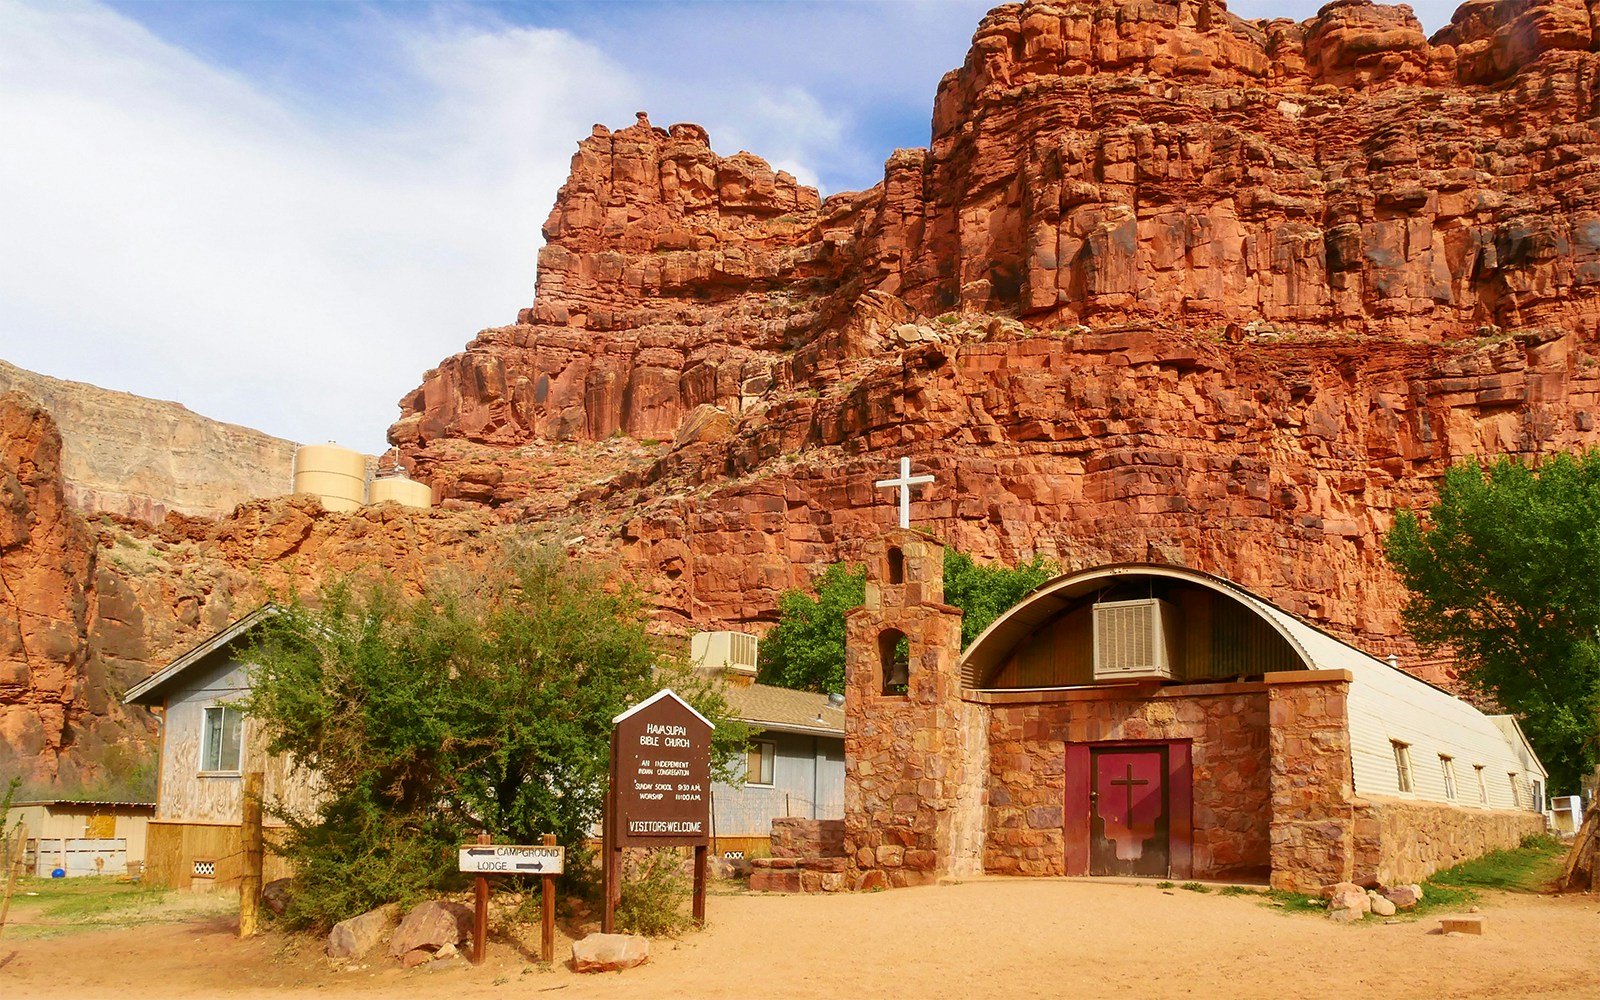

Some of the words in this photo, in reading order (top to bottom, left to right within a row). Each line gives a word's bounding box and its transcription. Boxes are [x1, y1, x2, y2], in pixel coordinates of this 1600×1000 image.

[646, 723, 687, 736] HAVASUPAI
[639, 735, 660, 747] BIBLE
[664, 737, 690, 748] CHURCH
[634, 783, 653, 791] SUNDAY
[629, 821, 667, 833] VISITORS
[667, 821, 702, 833] WELCOME
[496, 847, 560, 858] CAMPGROUND
[477, 861, 508, 871] LODGE
